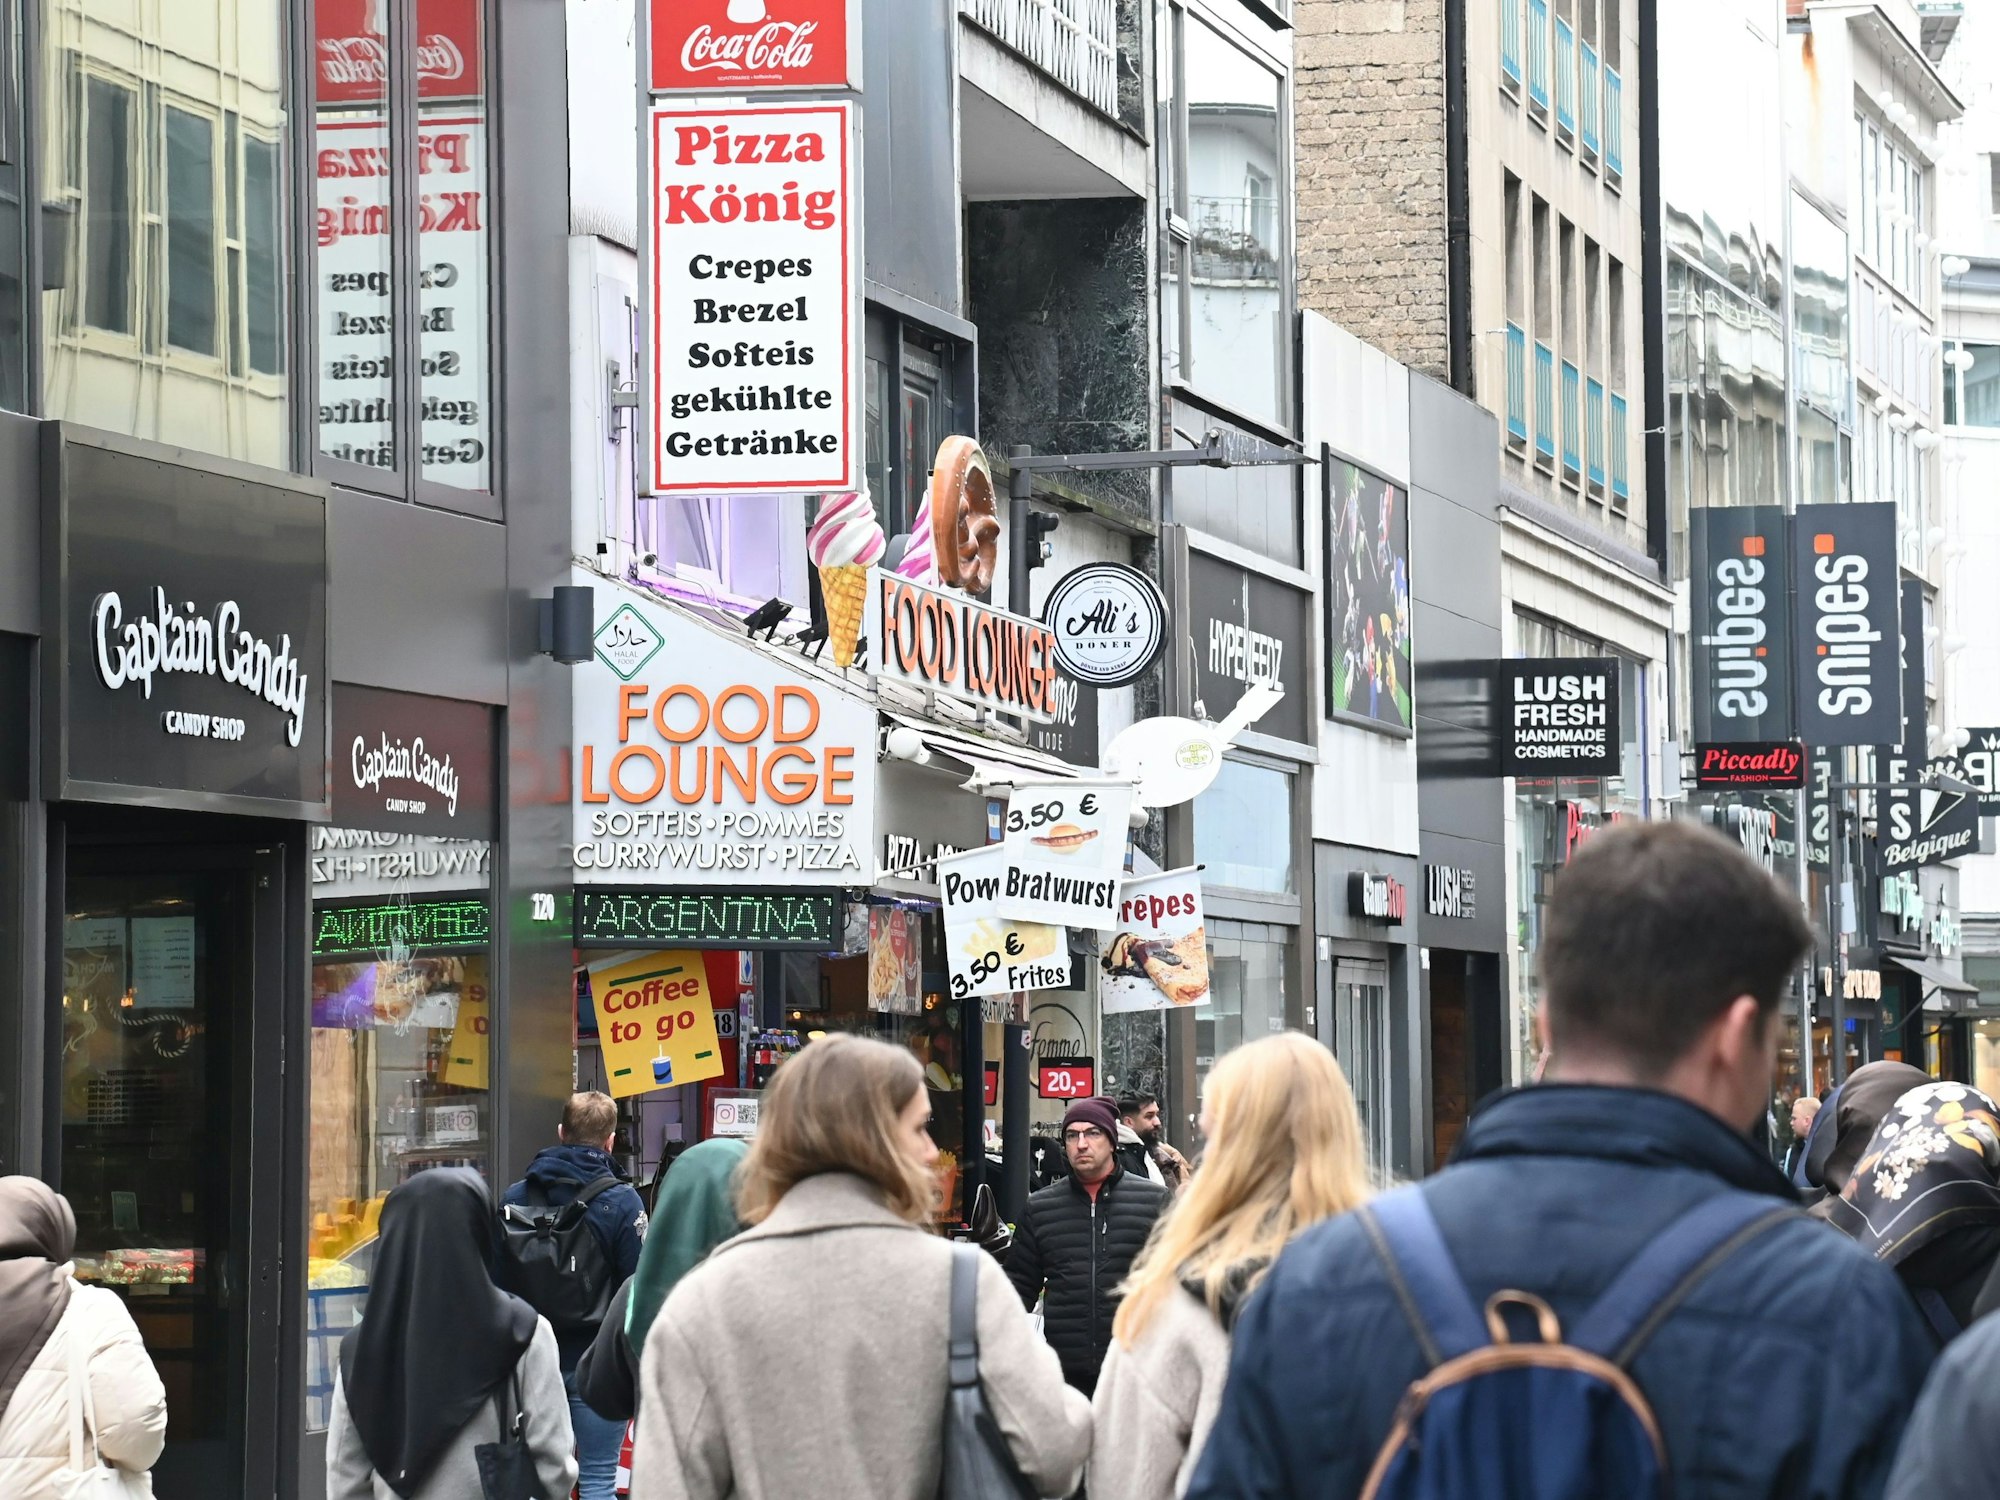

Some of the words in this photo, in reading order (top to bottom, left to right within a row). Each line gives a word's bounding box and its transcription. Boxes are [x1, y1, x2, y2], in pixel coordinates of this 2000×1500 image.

[681, 20, 819, 72] Coca-Cola
[674, 126, 824, 165] Pizza
[665, 181, 836, 229] König
[688, 254, 813, 284] Crepes
[694, 297, 808, 324] Brezel
[688, 339, 814, 368] Softeis
[670, 385, 832, 418] gekühlte
[666, 429, 838, 457] Getränke
[1066, 598, 1140, 636] Ali's
[606, 624, 647, 648] حلال
[884, 580, 958, 684] FOOD
[965, 606, 1056, 713] LOUNGE
[96, 585, 216, 699] Captain
[217, 601, 307, 748] Candy
[1514, 675, 1605, 702] LUSH
[165, 711, 209, 738] CANDY
[212, 716, 245, 741] SHOP
[619, 684, 820, 743] FOOD
[1514, 704, 1605, 726] FRESH
[1514, 728, 1606, 743] HANDMADE
[1514, 744, 1606, 759] COSMETICS
[352, 731, 411, 793] Captain
[412, 736, 458, 816] Candy
[582, 745, 854, 805] LOUNGE
[1702, 748, 1799, 774] Piccadly
[1730, 774, 1769, 782] FASHION
[386, 798, 407, 812] CANDY
[408, 799, 426, 814] SHOP
[1007, 801, 1064, 833] 3,50
[1079, 794, 1098, 815] €
[591, 810, 702, 838] SOFTEIS
[720, 811, 844, 838] POMMES
[573, 842, 767, 869] CURRYWURST
[782, 843, 860, 870] PIZZA
[888, 834, 922, 881] PIZZA
[1884, 829, 1971, 867] Belgique
[1005, 866, 1115, 909] Bratwurst
[1429, 865, 1461, 917] LUSH
[531, 893, 554, 921] 120
[594, 899, 818, 932] ARGENTINA
[1117, 893, 1195, 929] rêpes
[952, 951, 1001, 998] 3,50
[1005, 933, 1025, 956] €
[1008, 964, 1065, 989] Frites
[604, 975, 699, 1014] Coffee
[610, 1019, 641, 1044] to
[657, 1009, 695, 1041] go
[1047, 1071, 1085, 1095] 20,-
